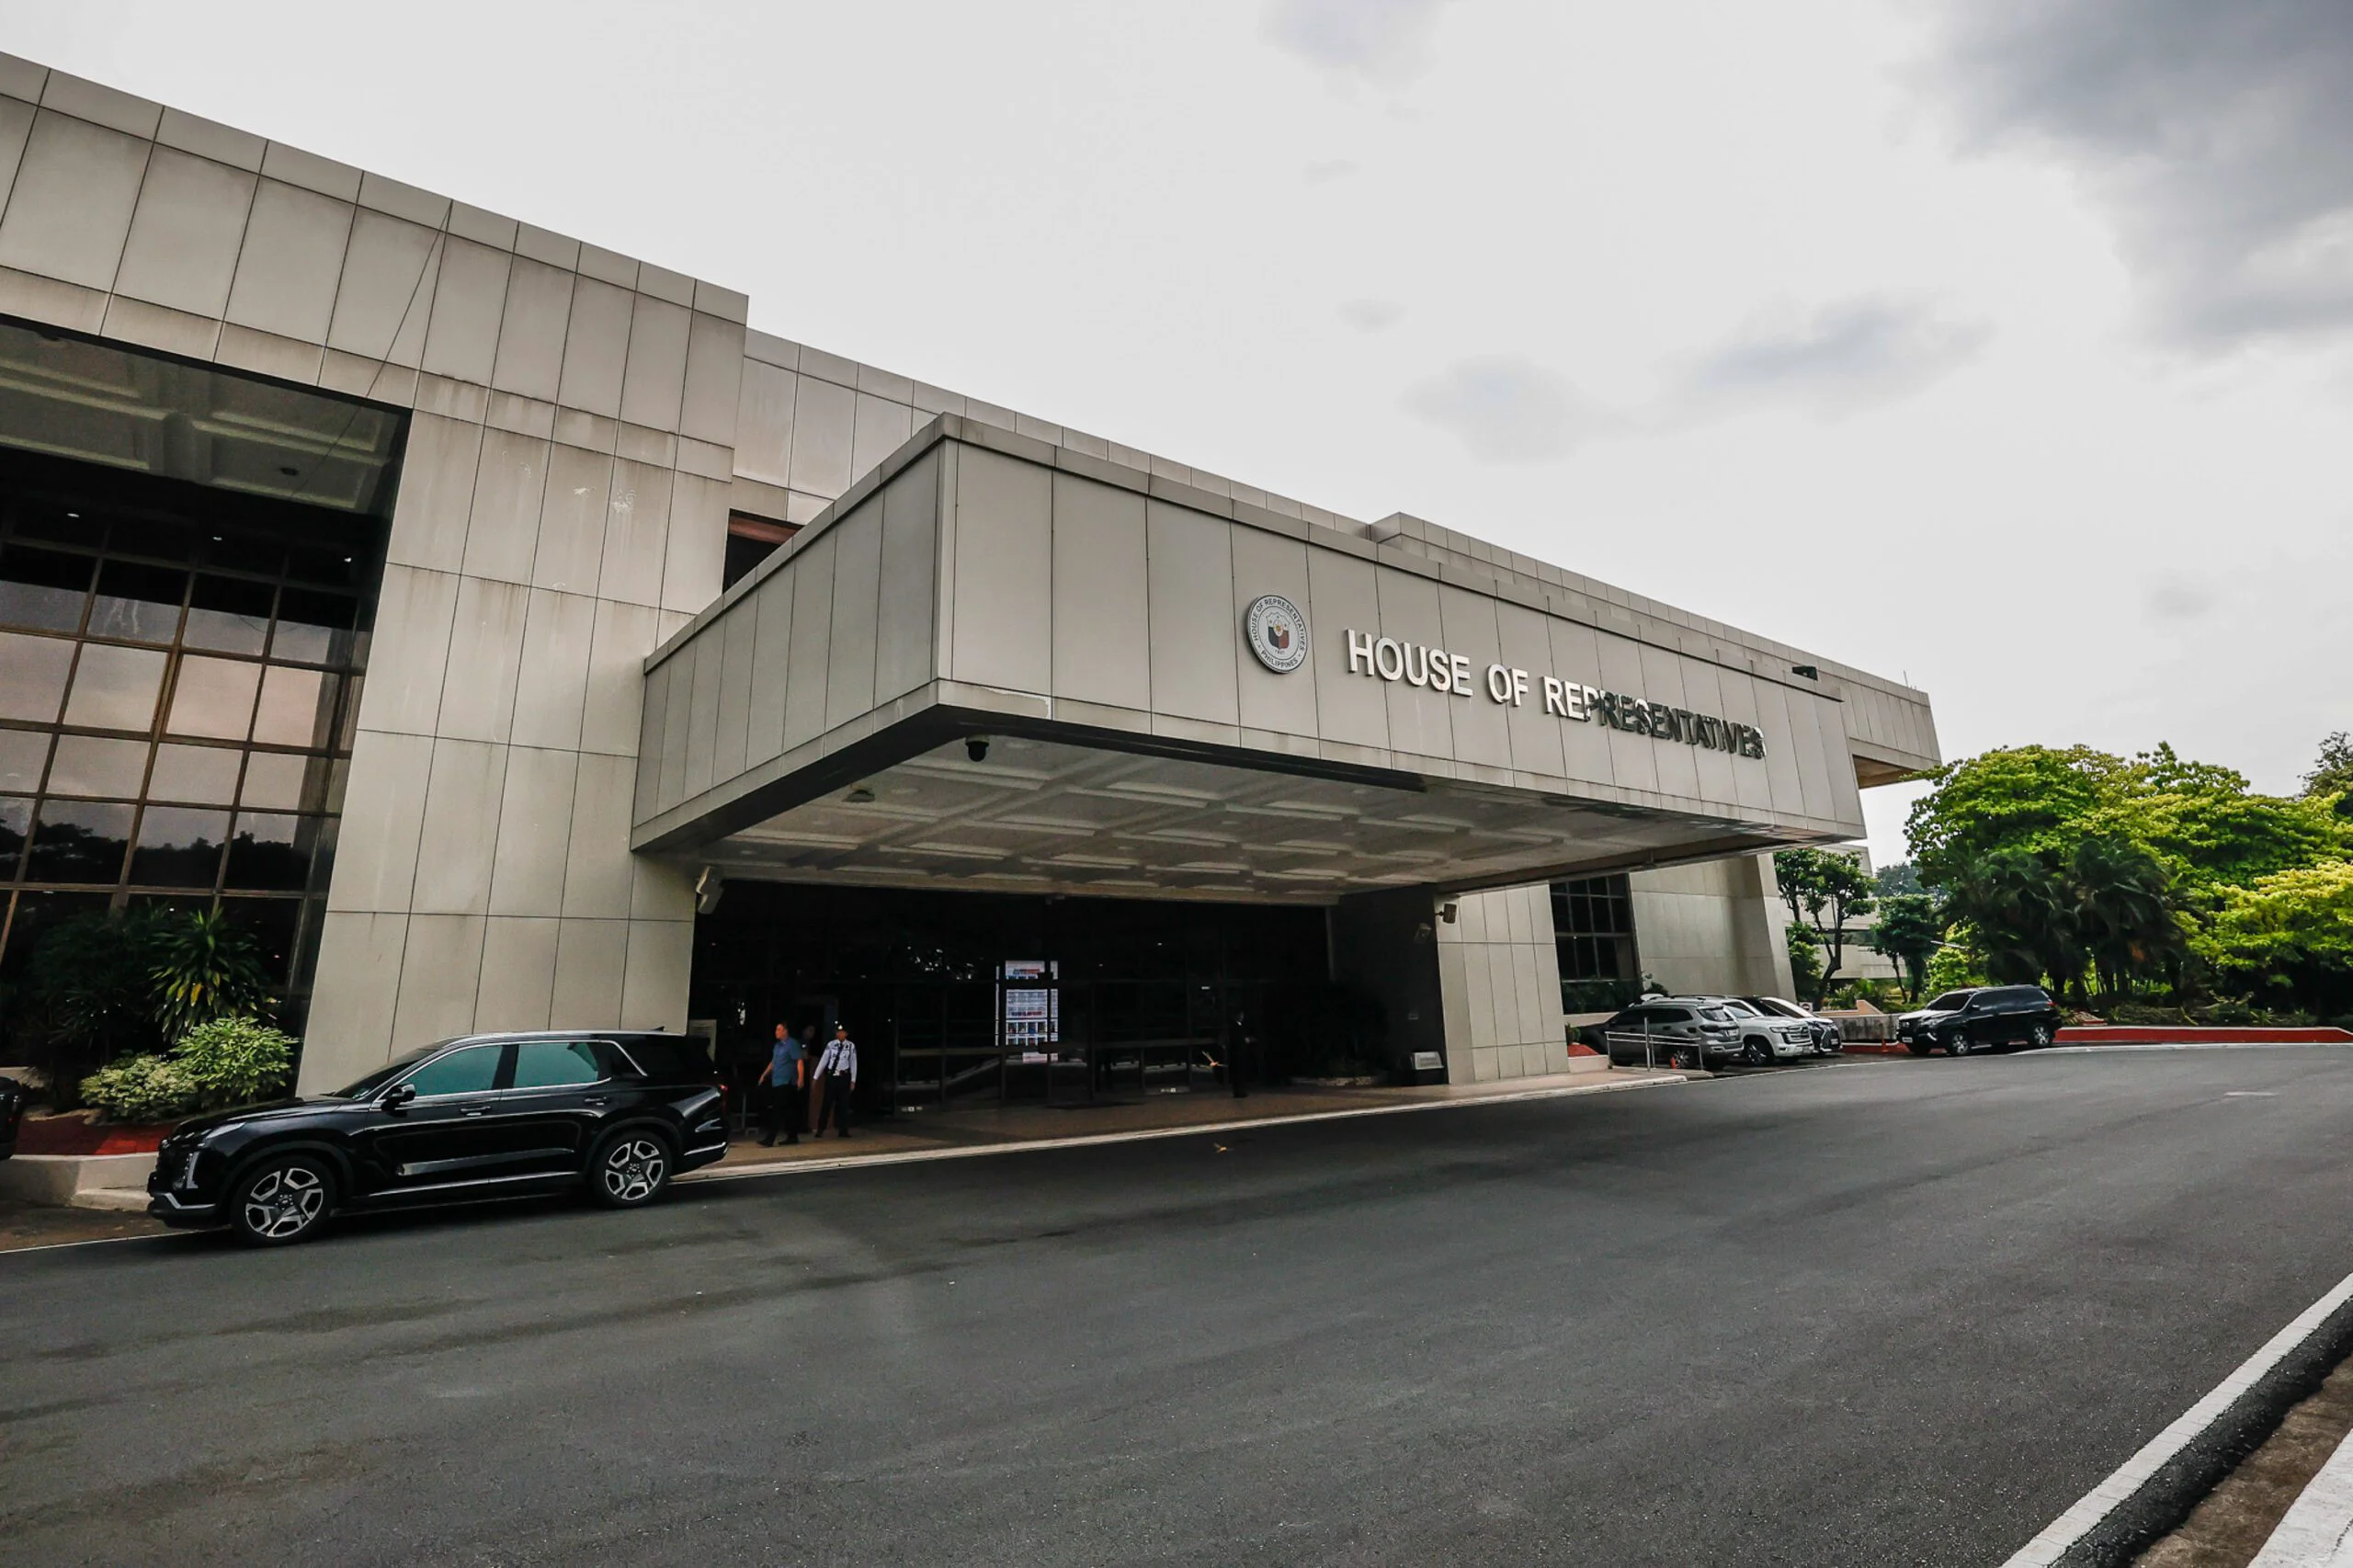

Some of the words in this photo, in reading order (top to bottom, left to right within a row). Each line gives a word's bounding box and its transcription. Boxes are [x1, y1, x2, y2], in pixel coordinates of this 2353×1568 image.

[1256, 602, 1265, 612] OF
[1265, 598, 1305, 651] REPRESENTATIVES
[1261, 650, 1298, 667] PHILIPPINES
[1345, 629, 1473, 697] HOUSE
[1487, 664, 1529, 707] OF
[1541, 676, 1768, 759] REPRESENTATIVES
